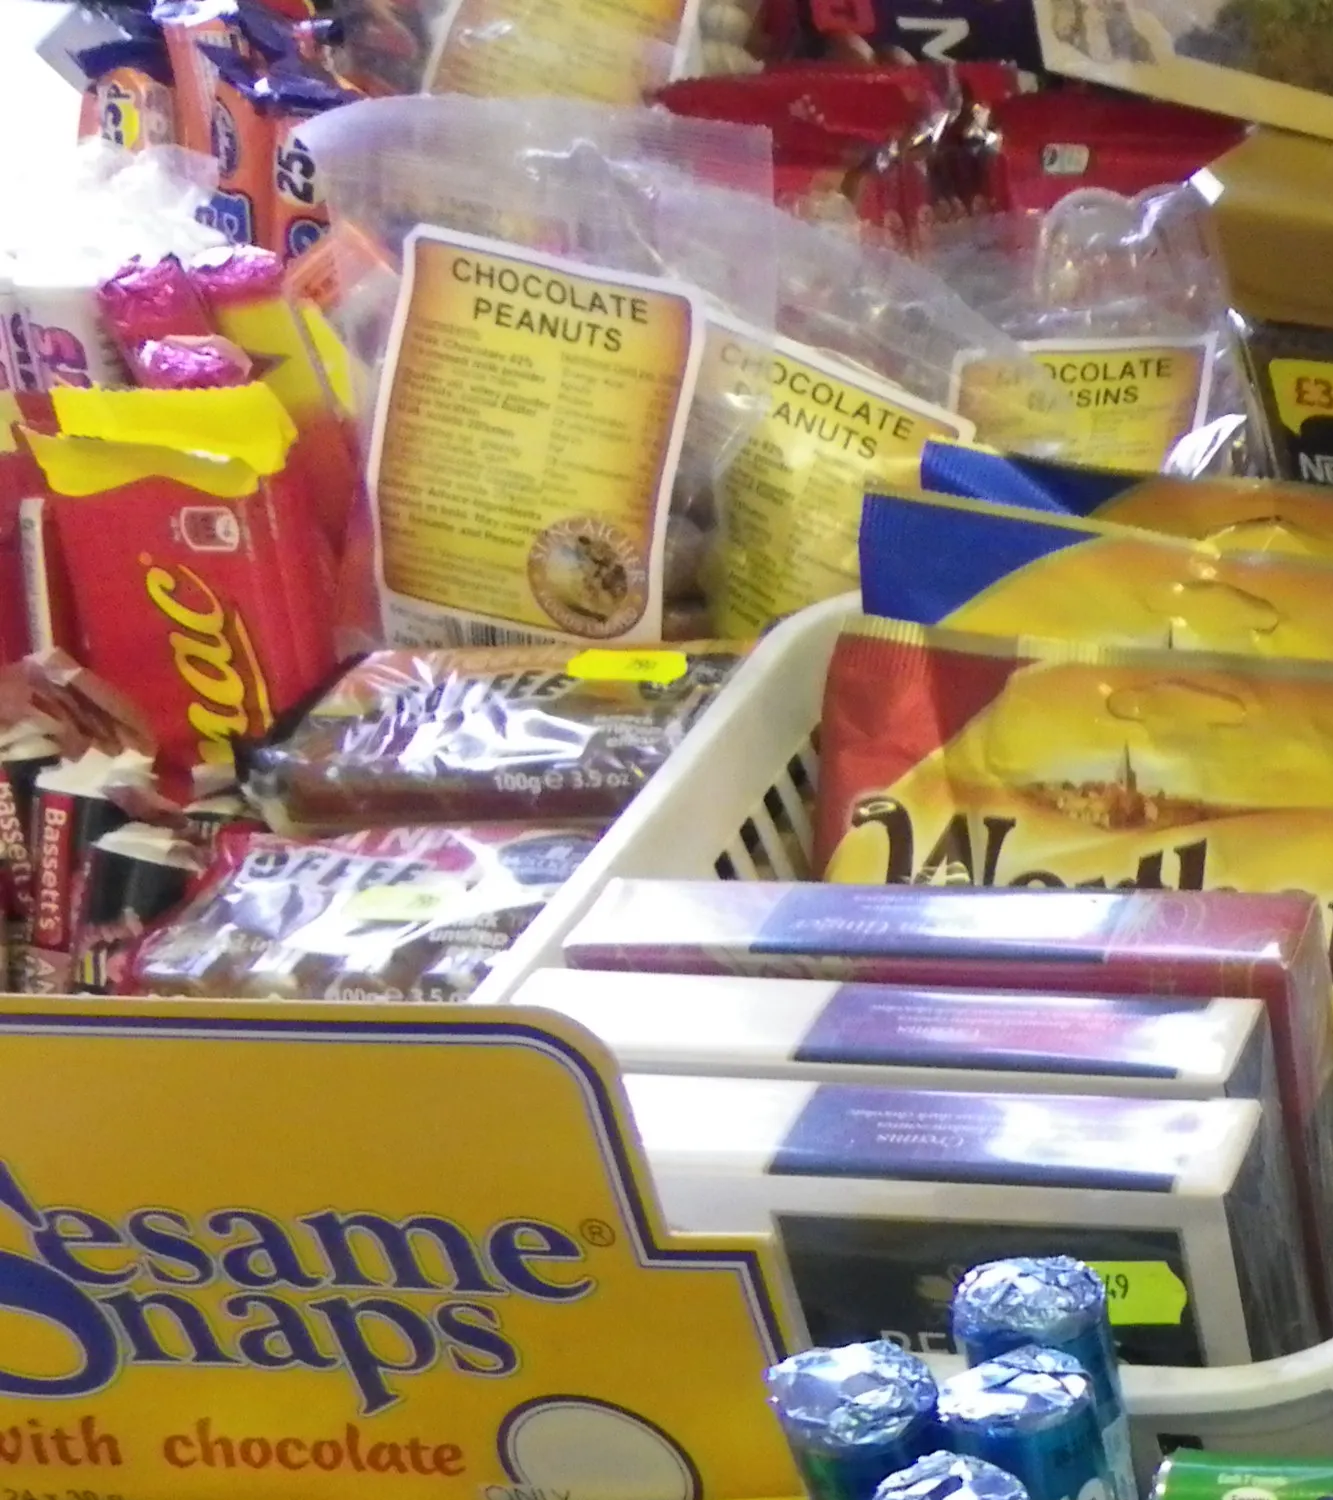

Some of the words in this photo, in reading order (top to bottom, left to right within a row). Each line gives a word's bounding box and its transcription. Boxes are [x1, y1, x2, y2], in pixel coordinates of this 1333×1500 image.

[452, 257, 649, 325] CHOCOLATE
[473, 297, 622, 353] PEANUTS
[162, 1416, 468, 1478] chocolate
